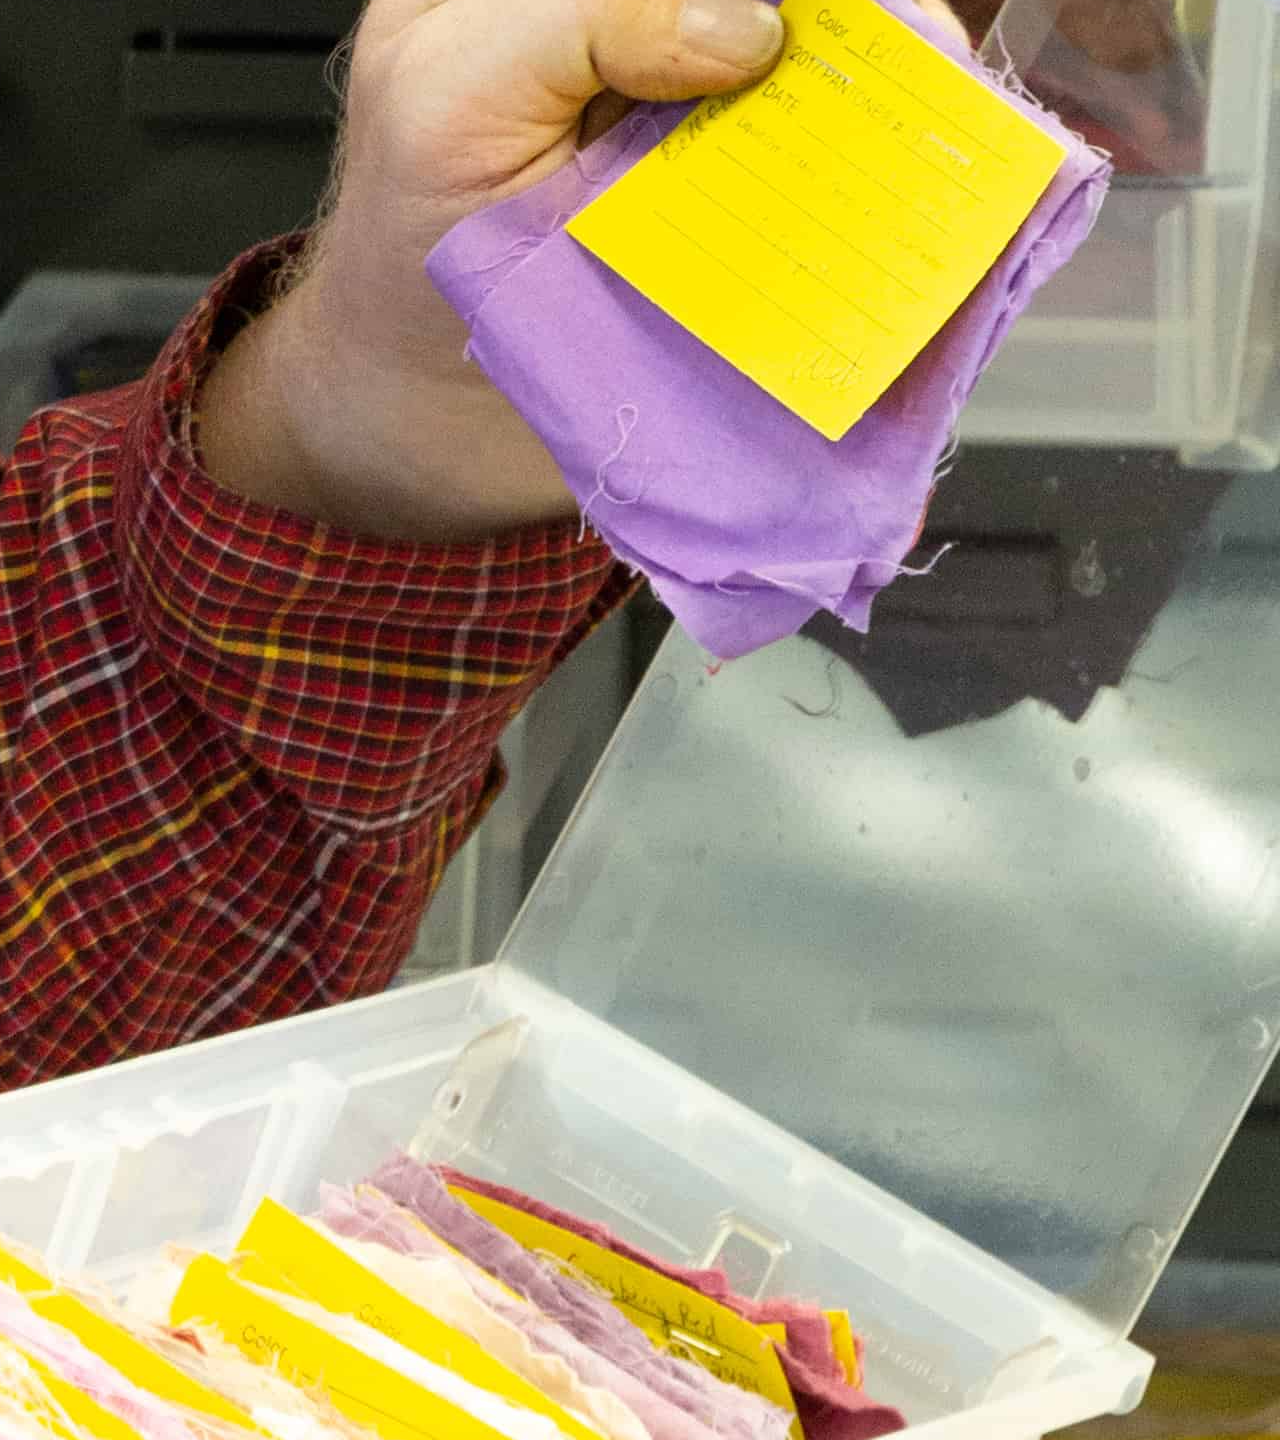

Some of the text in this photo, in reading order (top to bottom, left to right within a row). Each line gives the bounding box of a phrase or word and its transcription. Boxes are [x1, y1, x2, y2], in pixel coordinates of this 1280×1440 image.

[815, 8, 849, 38] Color
[788, 45, 821, 77] 2017
[761, 81, 800, 115] DATE
[241, 1324, 288, 1359] Color
